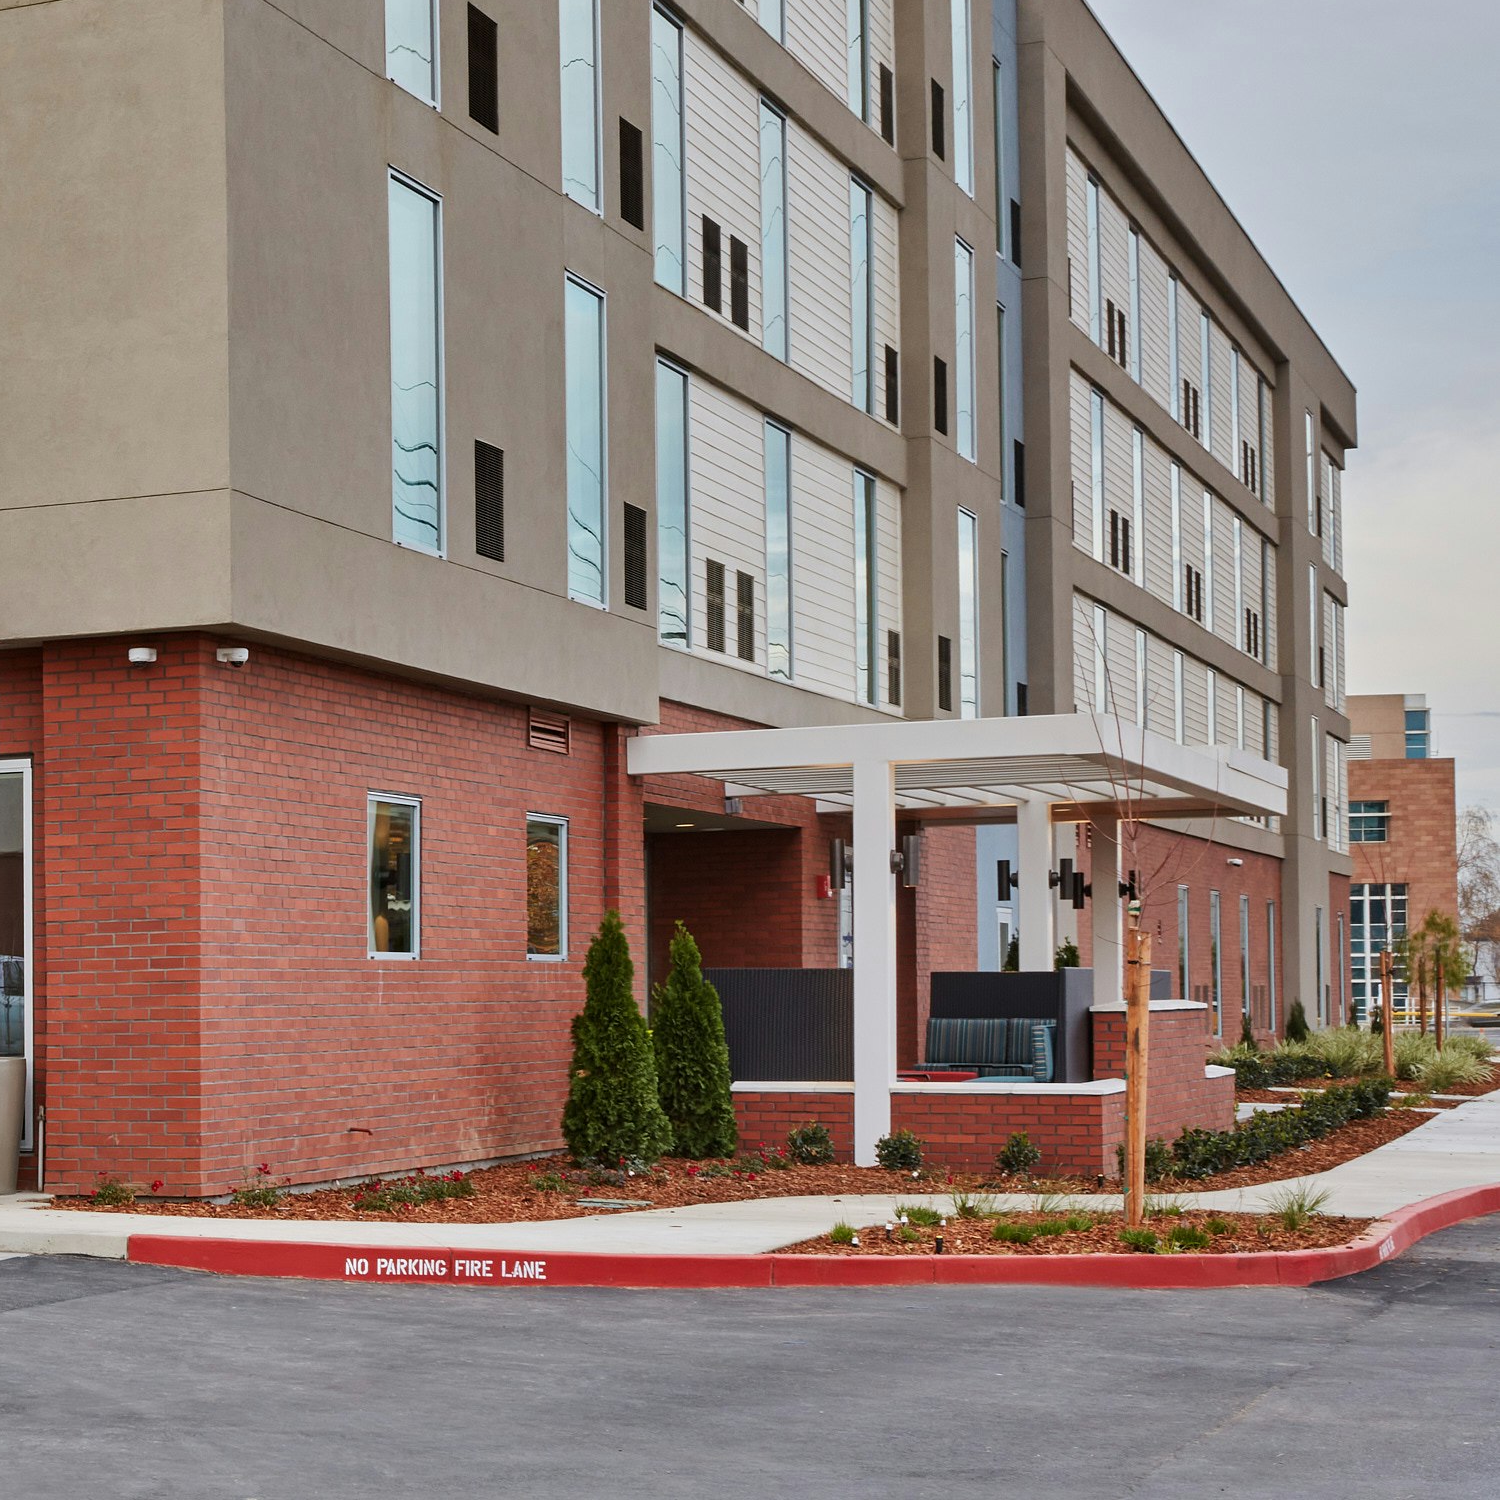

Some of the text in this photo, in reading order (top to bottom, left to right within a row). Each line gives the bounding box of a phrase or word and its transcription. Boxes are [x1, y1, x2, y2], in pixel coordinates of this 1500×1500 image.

[345, 1258, 547, 1280] NO PARKING FIRE LANE
